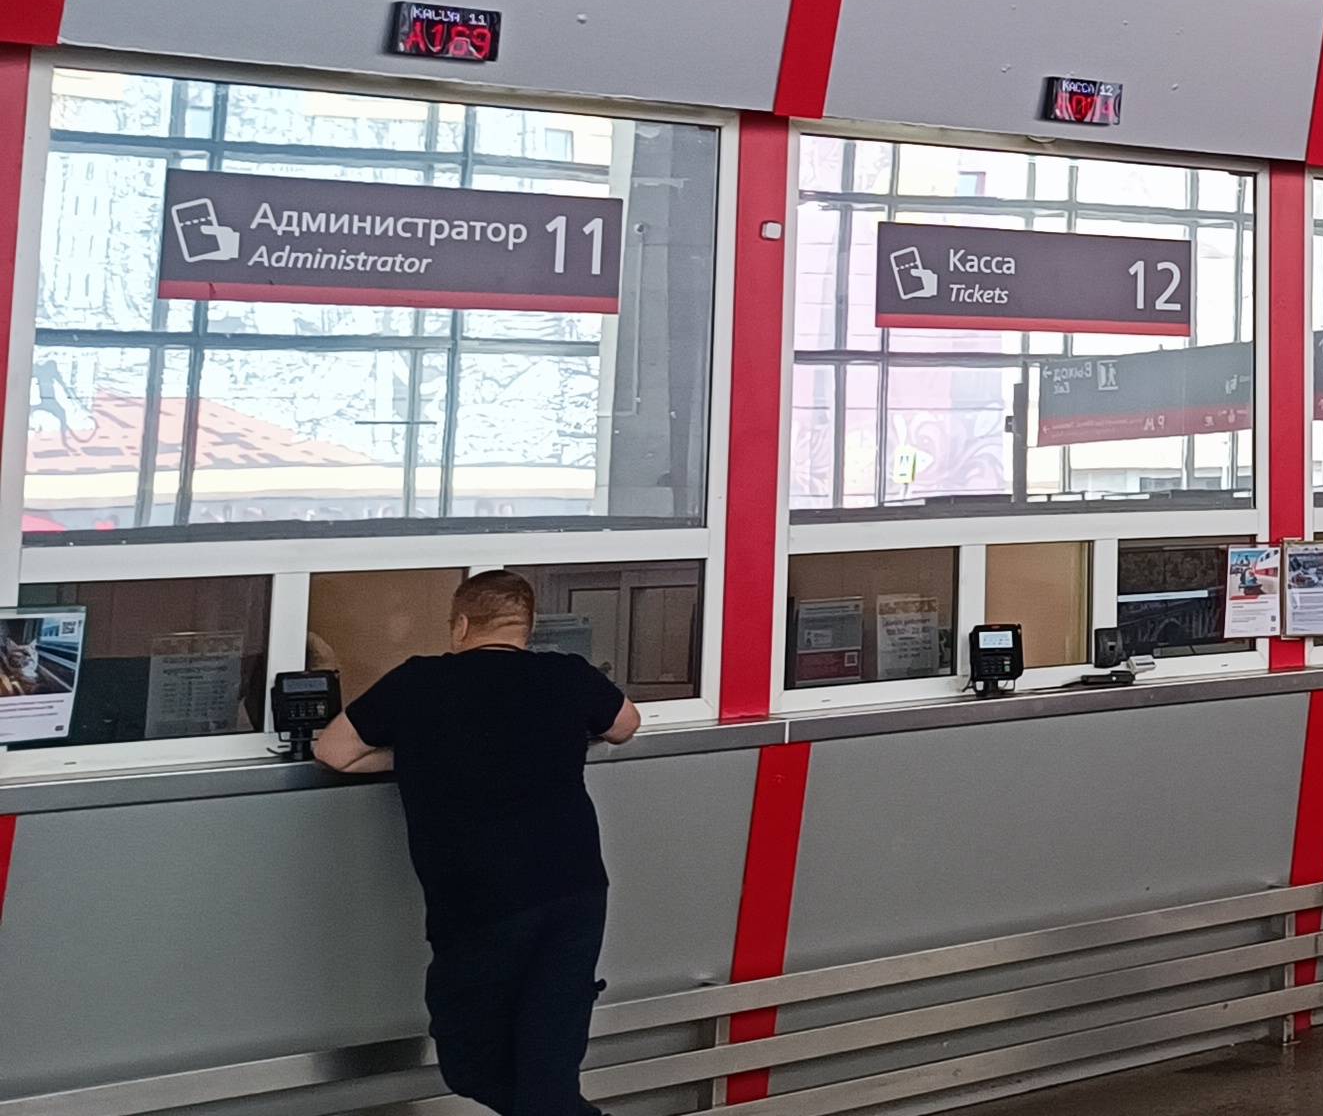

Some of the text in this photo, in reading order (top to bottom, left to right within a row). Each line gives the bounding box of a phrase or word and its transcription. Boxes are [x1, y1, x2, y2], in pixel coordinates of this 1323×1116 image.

[468, 13, 487, 26] 11
[1100, 84, 1113, 96] 12
[249, 201, 604, 275] Администратор 11
[248, 244, 432, 276] Administrator
[949, 249, 1182, 311] Касса 12
[949, 283, 1009, 305] Tickets
